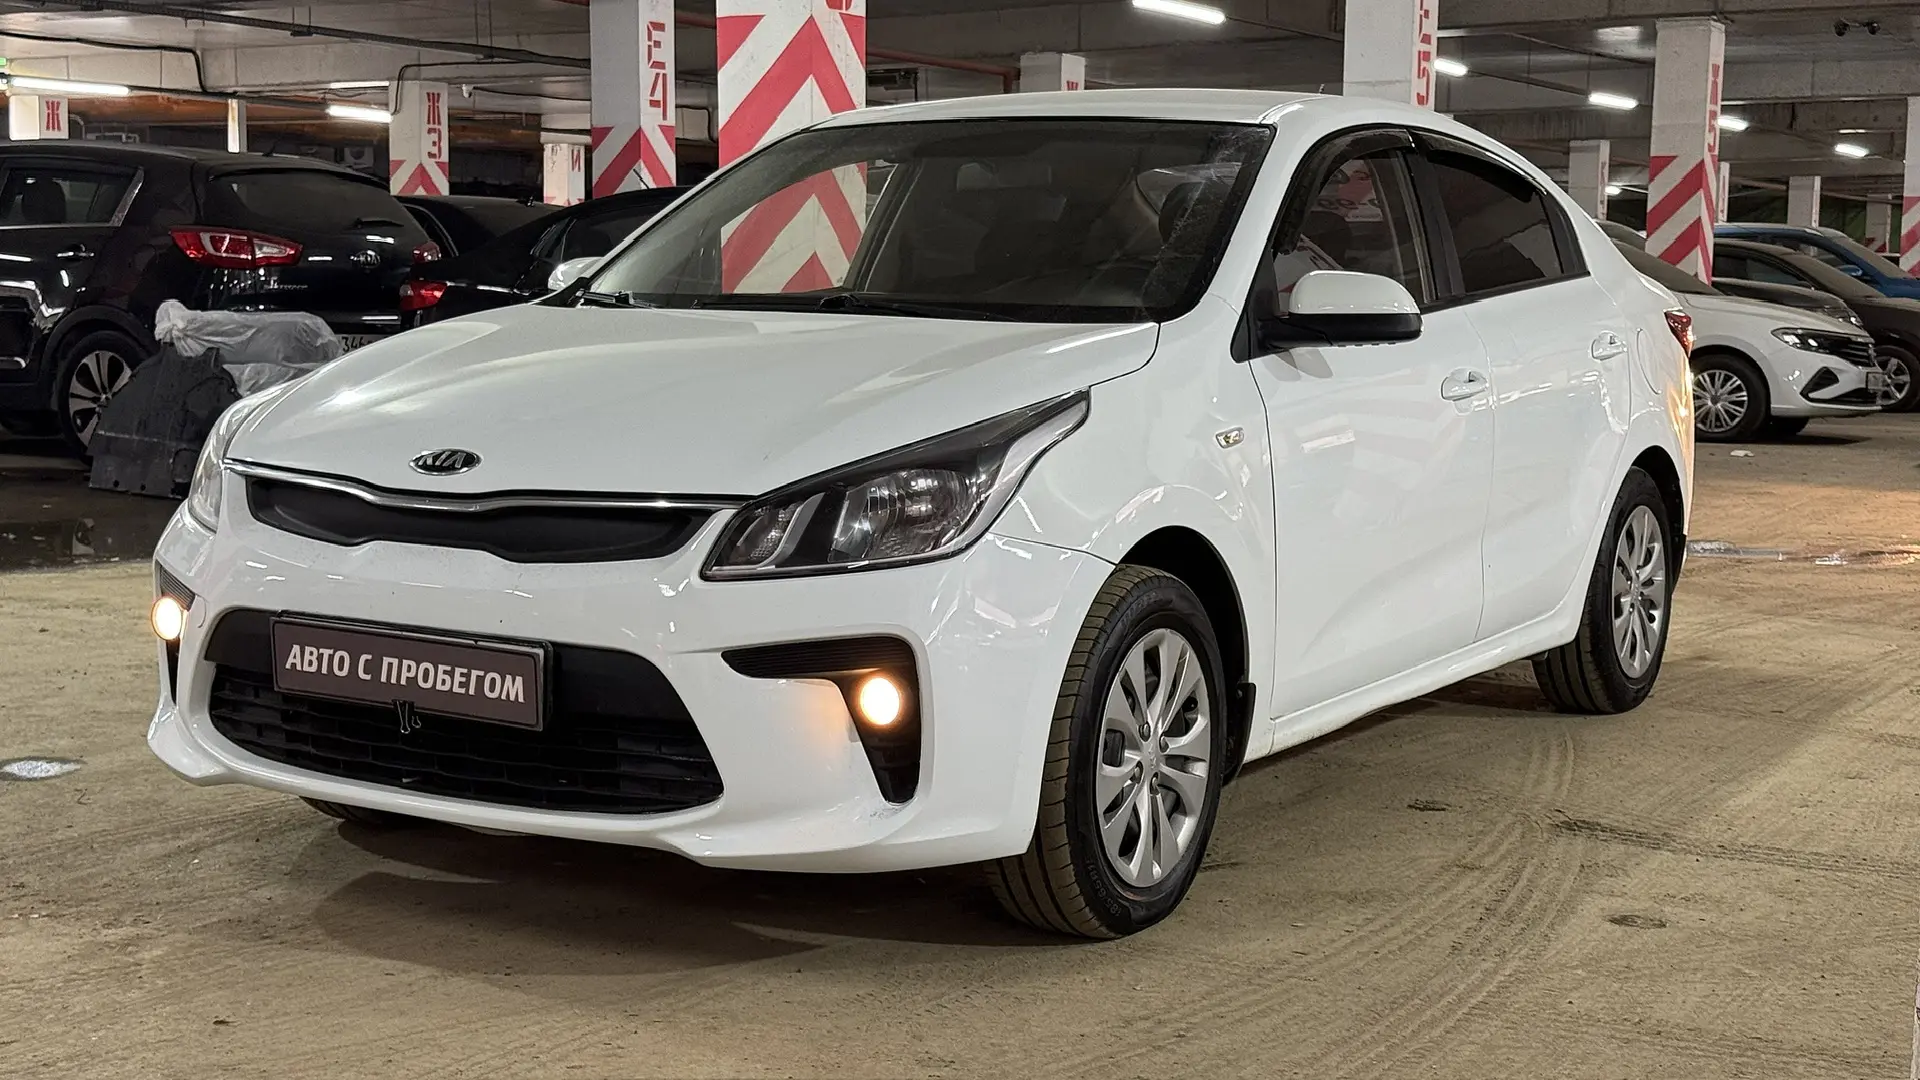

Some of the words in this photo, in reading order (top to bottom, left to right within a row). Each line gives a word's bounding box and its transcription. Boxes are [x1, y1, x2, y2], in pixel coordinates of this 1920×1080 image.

[45, 100, 61, 131] Ж
[285, 644, 350, 677] АВТО
[357, 654, 373, 681] С
[380, 656, 525, 703] ПРОБЕГОМ
